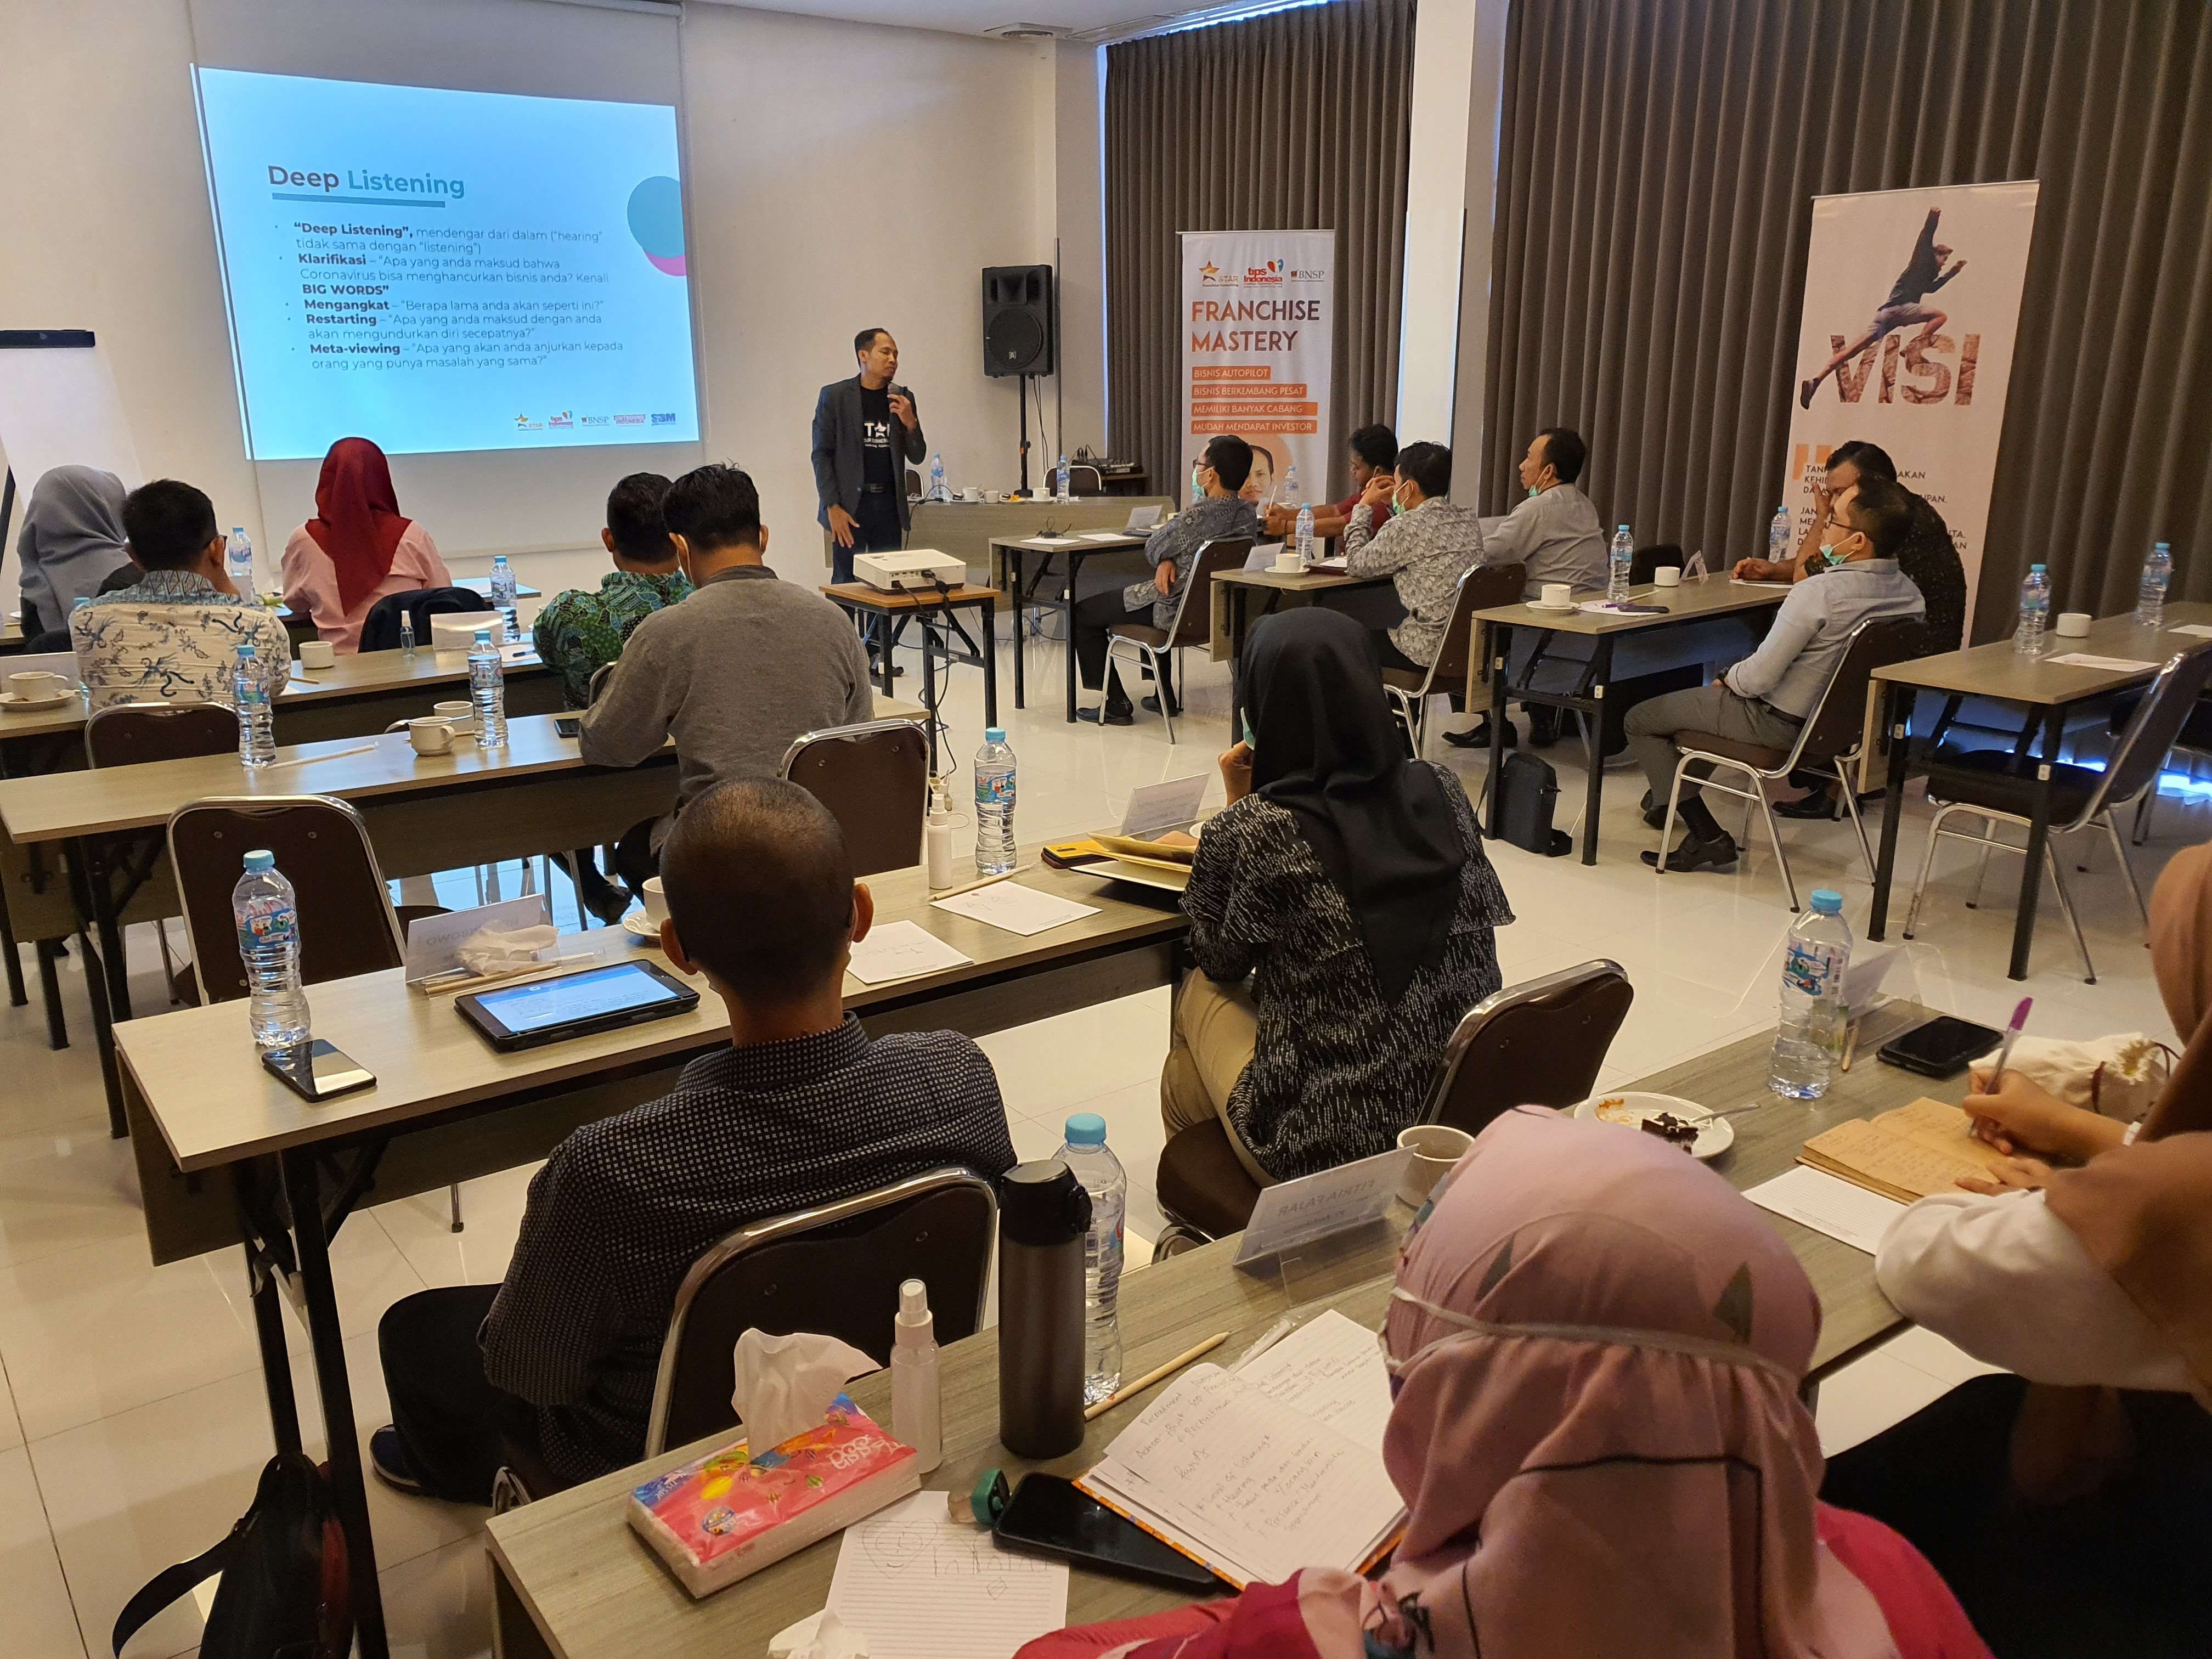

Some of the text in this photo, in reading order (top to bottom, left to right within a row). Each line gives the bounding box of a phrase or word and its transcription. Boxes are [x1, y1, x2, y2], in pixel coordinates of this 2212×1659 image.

[268, 166, 465, 199] Deep Listening
[416, 228, 484, 240] mendengar
[488, 229, 509, 240] dari
[512, 229, 547, 240] dalam
[296, 238, 329, 249] tidak
[332, 240, 368, 250] sama
[369, 239, 416, 253] dengan
[298, 253, 366, 266] Klarifikasi
[411, 258, 439, 269] yang
[442, 258, 471, 268] anda
[475, 258, 520, 268] maksud
[523, 258, 560, 269] bahwa
[300, 268, 609, 284] Coronavirus bisa menghancurkan bisnis anda? Kenali
[1248, 267, 1267, 276] tips
[1299, 270, 1324, 279] BNSP
[302, 284, 326, 295] BIG
[304, 299, 390, 312] Mengangkat
[451, 300, 478, 311] lama
[482, 301, 510, 311] anda
[513, 300, 539, 311] akan
[543, 301, 578, 312] seperti
[1192, 300, 1321, 321] FRANCHISE
[306, 314, 377, 326] Restarting
[420, 315, 448, 326] yang
[452, 314, 479, 324] anda
[483, 314, 527, 324] maksud
[531, 314, 572, 325] dengan
[575, 314, 602, 324] anda
[308, 329, 339, 339] akan
[343, 329, 438, 341] mengundurkan
[441, 329, 459, 339] diri
[1192, 330, 1299, 352] MASTERY
[310, 343, 400, 355] Meta-viewing
[442, 345, 471, 354] yang
[473, 342, 500, 352] akan
[504, 342, 531, 352] anda
[534, 342, 582, 353] anjurkan
[585, 341, 623, 352] kepada
[312, 360, 348, 371] orang
[353, 360, 383, 371] yang
[386, 359, 423, 370] punya
[426, 357, 474, 368] masalah
[477, 358, 505, 369] yang
[1830, 334, 1980, 405] VISI
[1194, 368, 1268, 378] BISNIS AUTOPILOT
[1194, 386, 1304, 396] BISNIS BERKEMBANG PESAT
[1194, 404, 1302, 413] MEMILIKI BANYAK CABANG
[1193, 422, 1312, 431] MUDAH MENDAPAT INVESTOR
